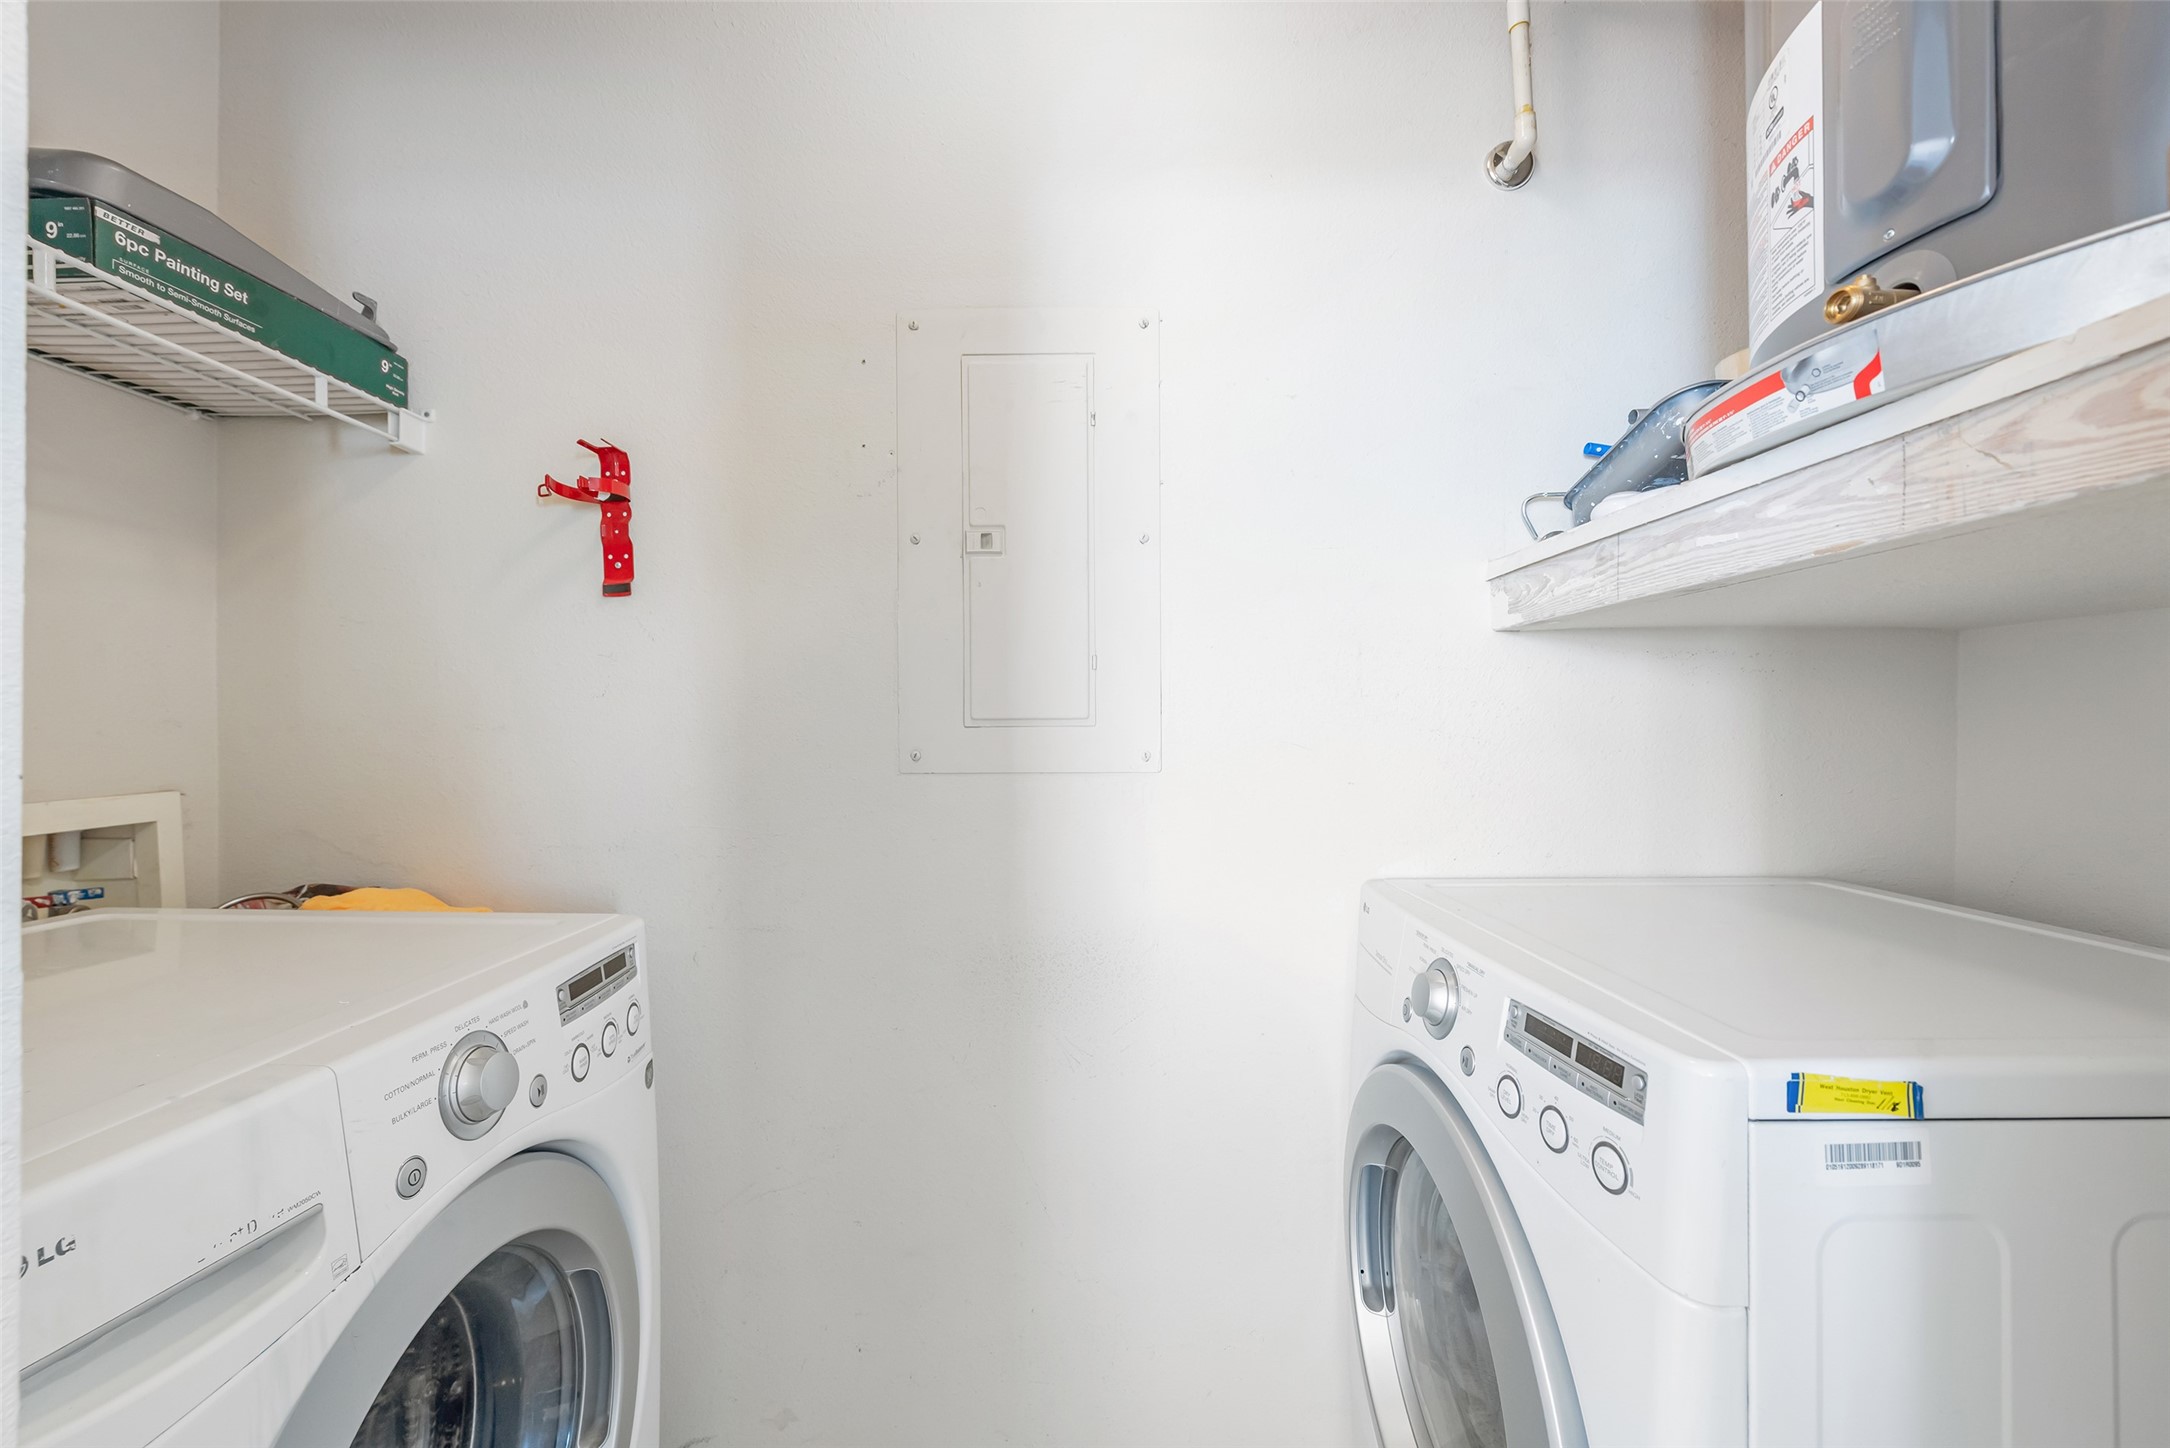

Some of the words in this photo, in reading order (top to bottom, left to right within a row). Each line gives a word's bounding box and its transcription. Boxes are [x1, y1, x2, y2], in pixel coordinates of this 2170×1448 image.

[1776, 121, 1811, 163] DANGER
[45, 221, 58, 239] 9
[102, 211, 146, 236] BETTER
[114, 230, 150, 257] 6pc
[154, 248, 220, 293] Painting
[223, 282, 249, 305] Set
[119, 257, 150, 274] SURFACE
[118, 265, 155, 288] Smooth
[156, 282, 166, 293] to
[167, 288, 222, 318] Semi-Smooth
[223, 313, 256, 333] Surfaces
[381, 359, 389, 373] 9
[454, 1015, 481, 1033] DELICATES
[488, 1015, 500, 1025] HAND
[499, 1010, 512, 1020] WASH
[503, 1027, 516, 1038] SPEED
[515, 1020, 530, 1031] WASH
[411, 1050, 429, 1064] PERM.
[429, 1040, 448, 1055] PRESS
[383, 1070, 436, 1102] COTTON/NORMAL
[1862, 1087, 1878, 1097] Dryer
[391, 1097, 433, 1125] BULKY/LARGE
[1602, 1126, 1622, 1142] MEDIUM
[1594, 1160, 1620, 1181] CONTROL
[1598, 1156, 1614, 1169] TEMP
[37, 1234, 77, 1267] LG
